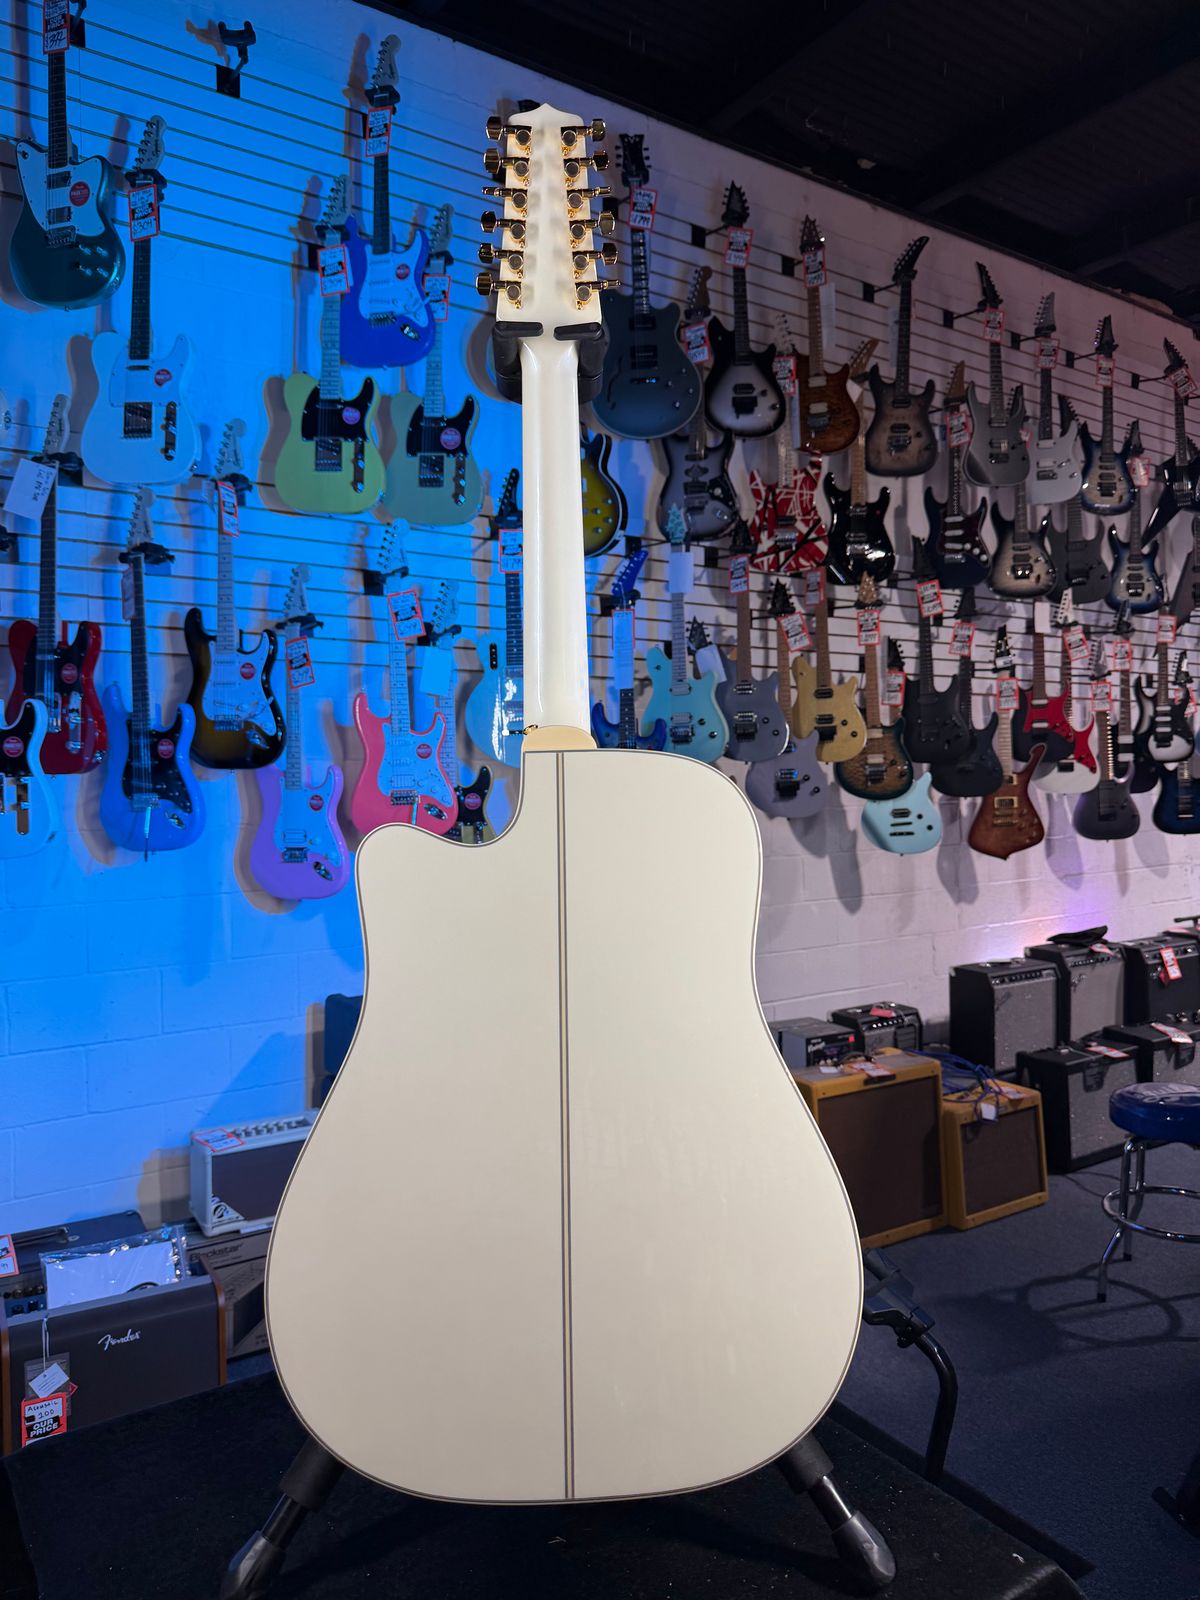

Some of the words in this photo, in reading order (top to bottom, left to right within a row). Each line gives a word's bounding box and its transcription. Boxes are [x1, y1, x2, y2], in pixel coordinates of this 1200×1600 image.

[97, 1328, 141, 1351] Fender
[38, 1408, 54, 1420] 200
[30, 1422, 58, 1438] PRICE
[33, 1418, 54, 1430] OUR
